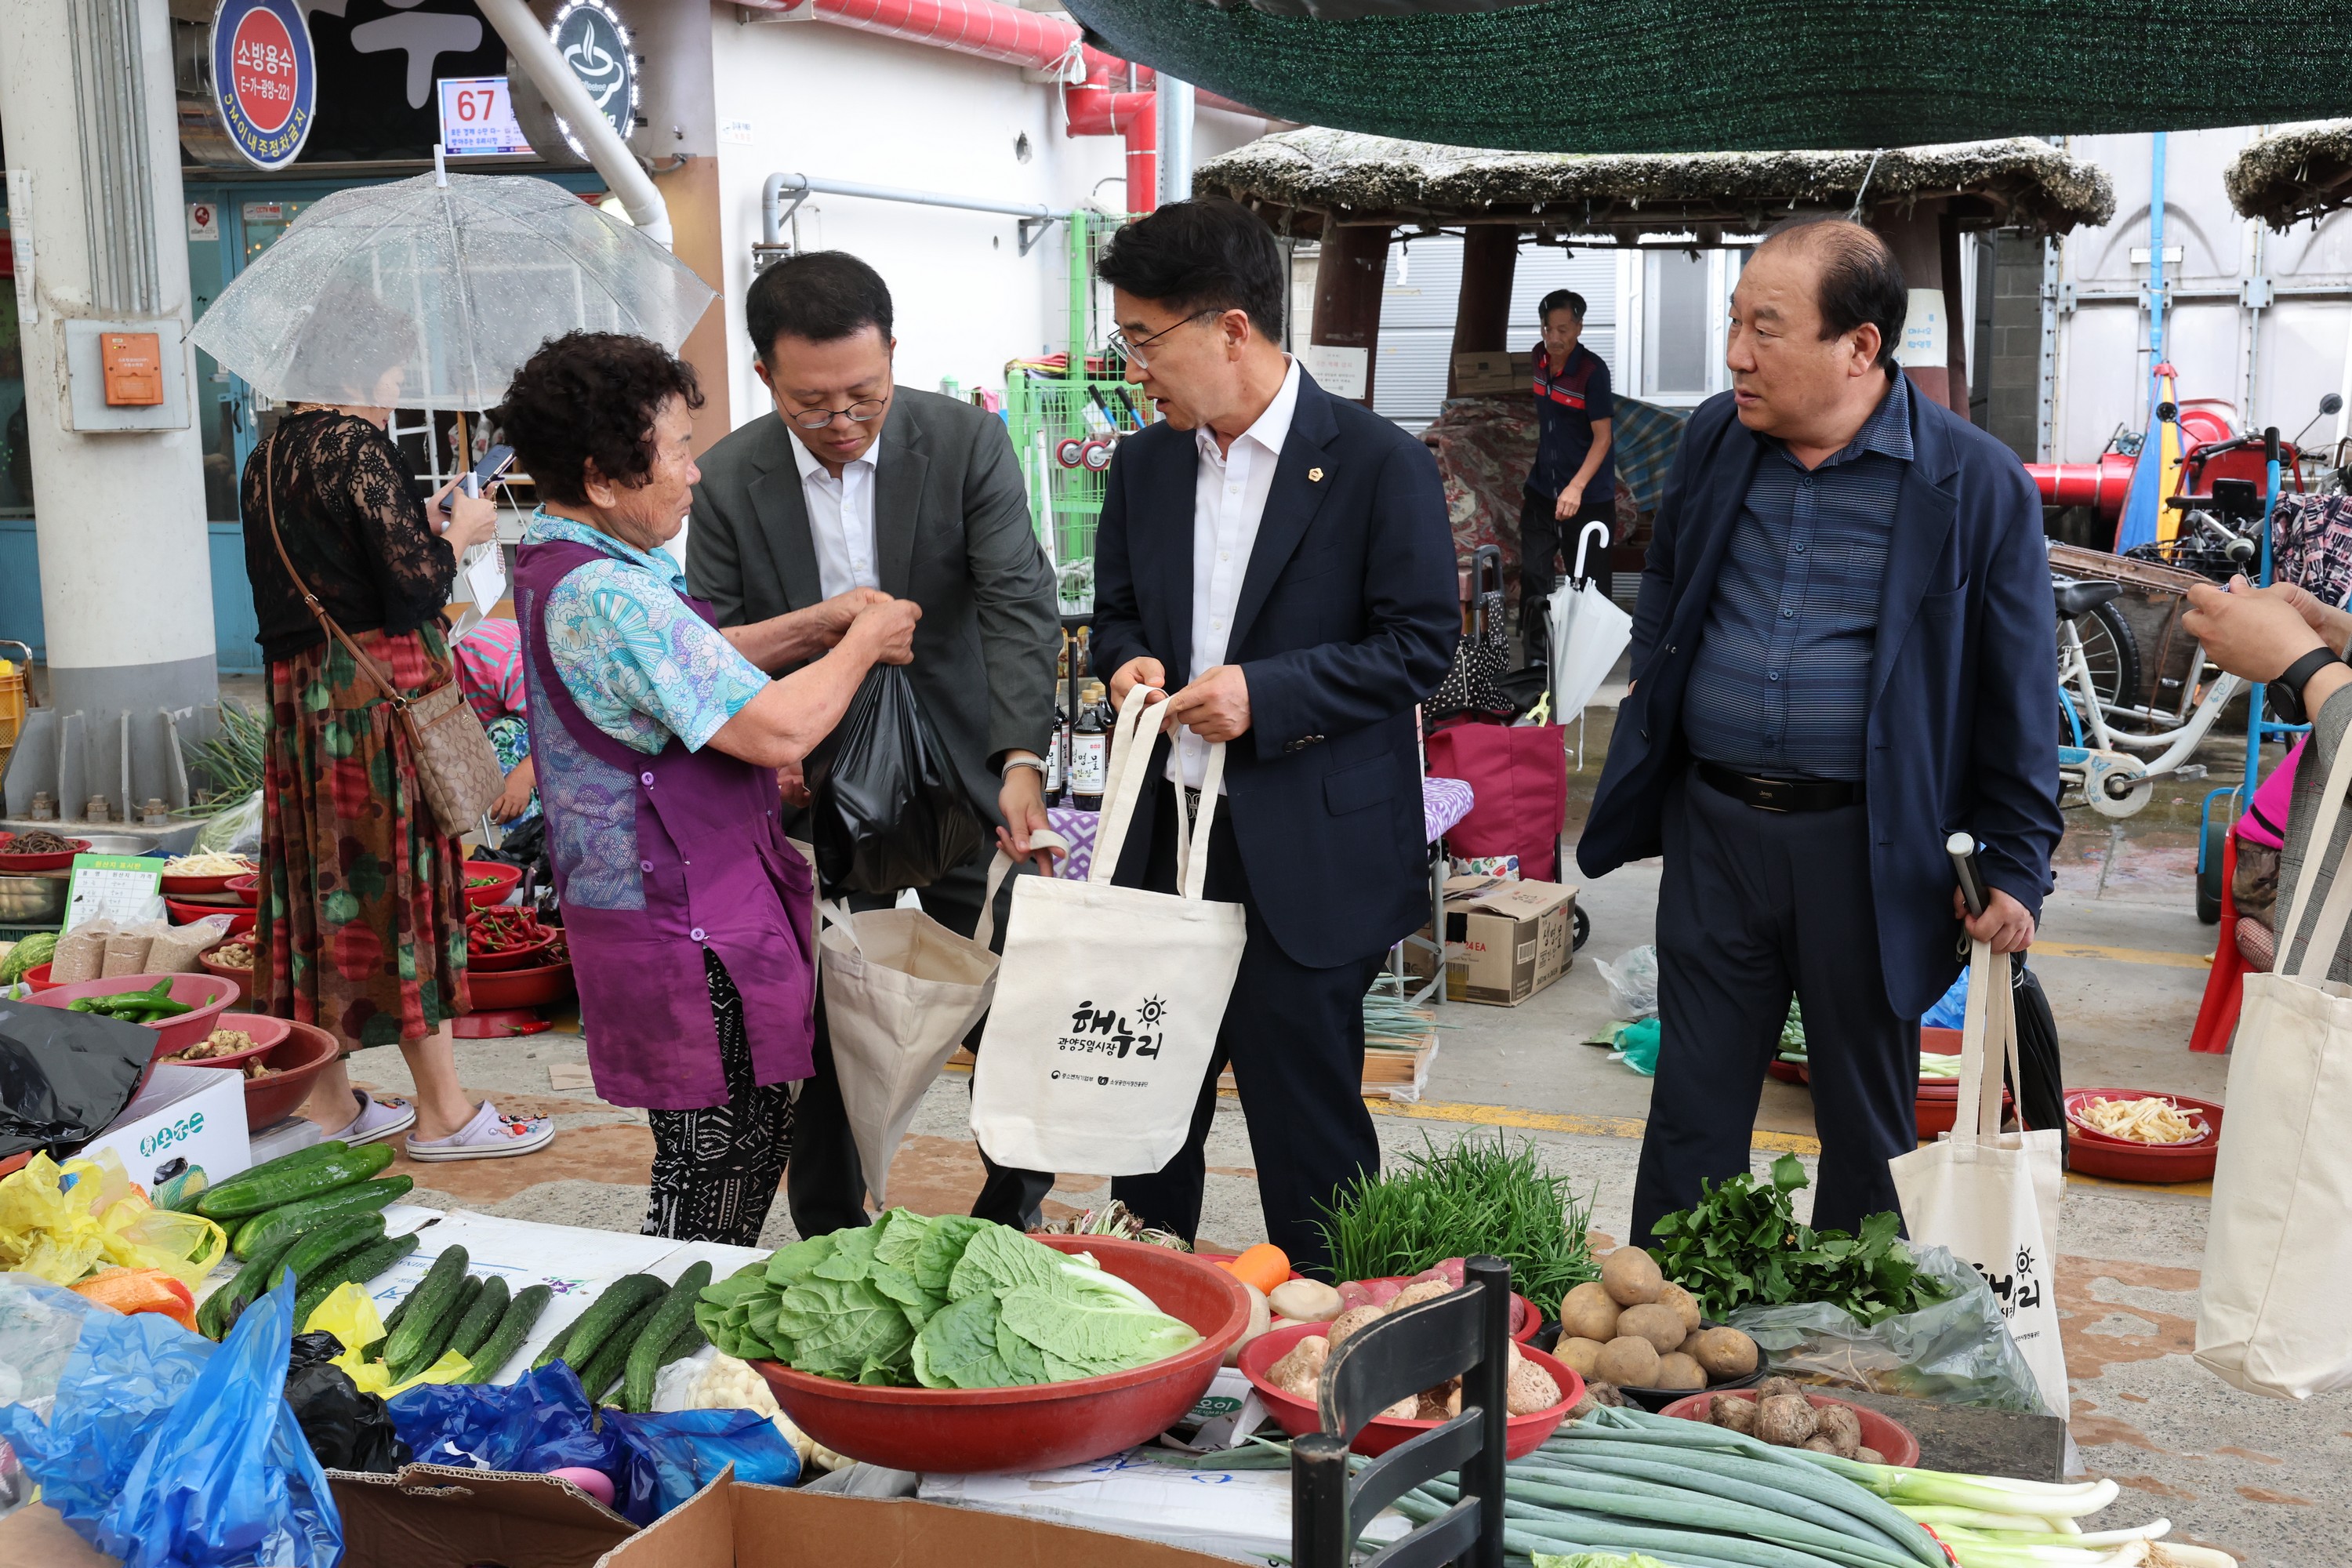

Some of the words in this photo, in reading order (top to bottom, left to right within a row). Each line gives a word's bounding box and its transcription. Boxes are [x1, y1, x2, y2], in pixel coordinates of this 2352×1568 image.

[238, 40, 292, 76] 소방용수
[241, 76, 290, 101] E-가-광양-221
[458, 89, 495, 122] 67
[1475, 942, 1486, 952] EA
[1072, 1000, 1163, 1060] 해누리
[1058, 1037, 1117, 1056] 광양5일시장
[1062, 1073, 1094, 1082] 중소벤처기업부
[1195, 1399, 1232, 1410] 오이
